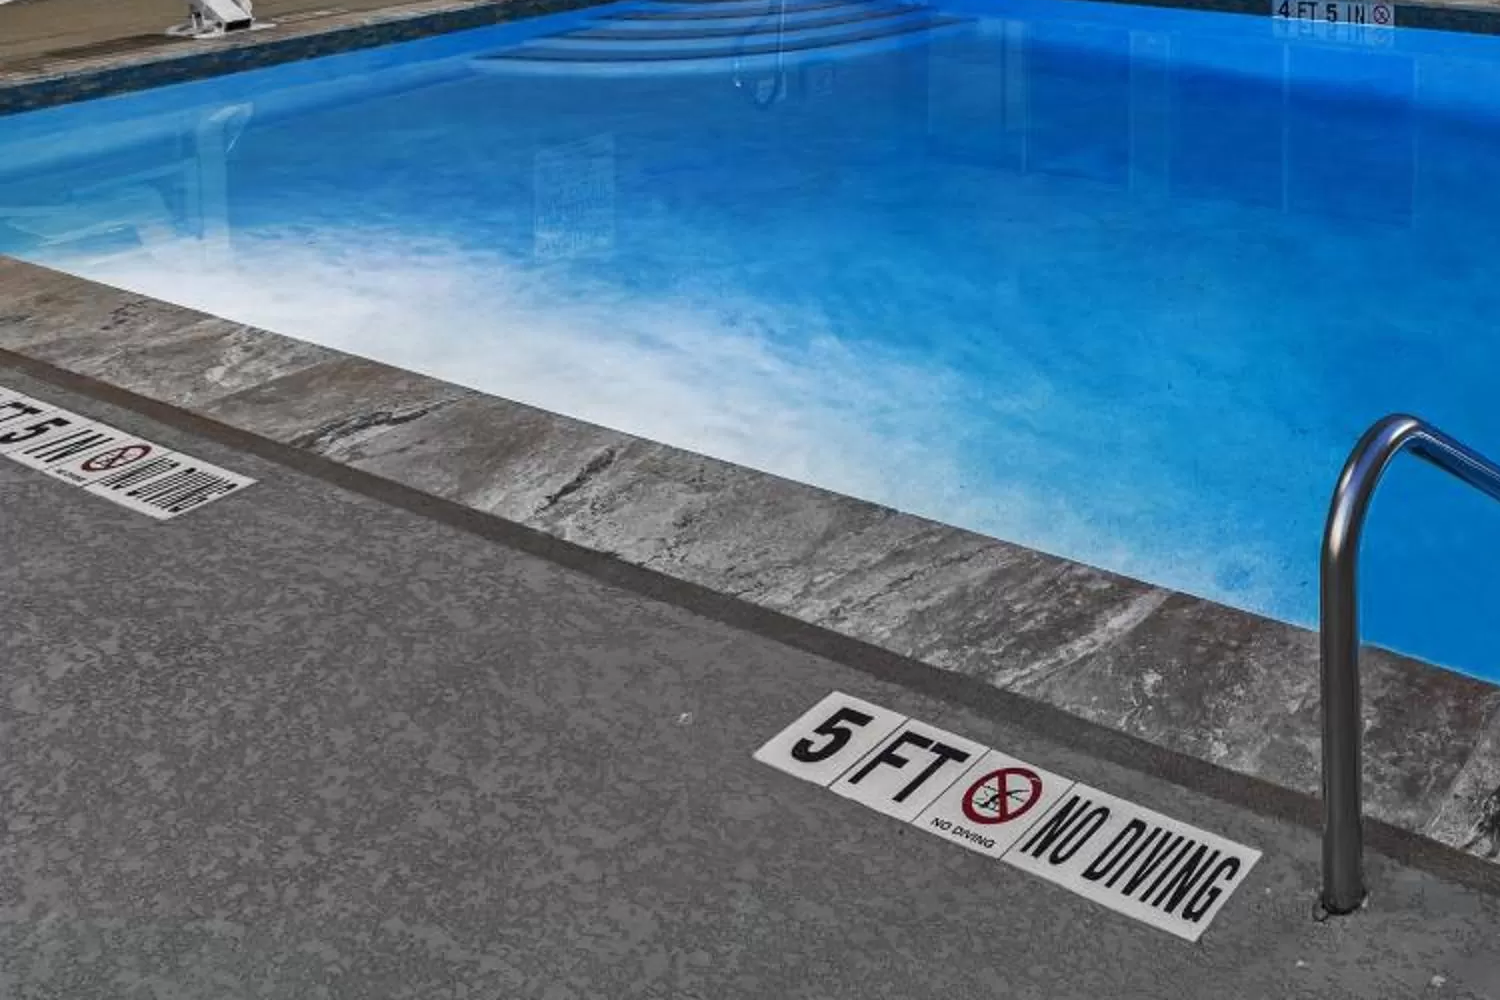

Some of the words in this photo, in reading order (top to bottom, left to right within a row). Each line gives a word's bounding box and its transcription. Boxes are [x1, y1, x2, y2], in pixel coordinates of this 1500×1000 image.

[1278, 0, 1290, 18] 4
[1297, 1, 1319, 21] FT
[1326, 3, 1338, 23] 5
[1347, 4, 1365, 24] IN
[23, 428, 115, 463] IN
[791, 706, 875, 763] 5
[847, 730, 972, 803] FT
[1019, 794, 1112, 866] NO
[1080, 817, 1242, 924] DIVING
[930, 817, 953, 831] NO
[951, 825, 996, 849] DIVING
